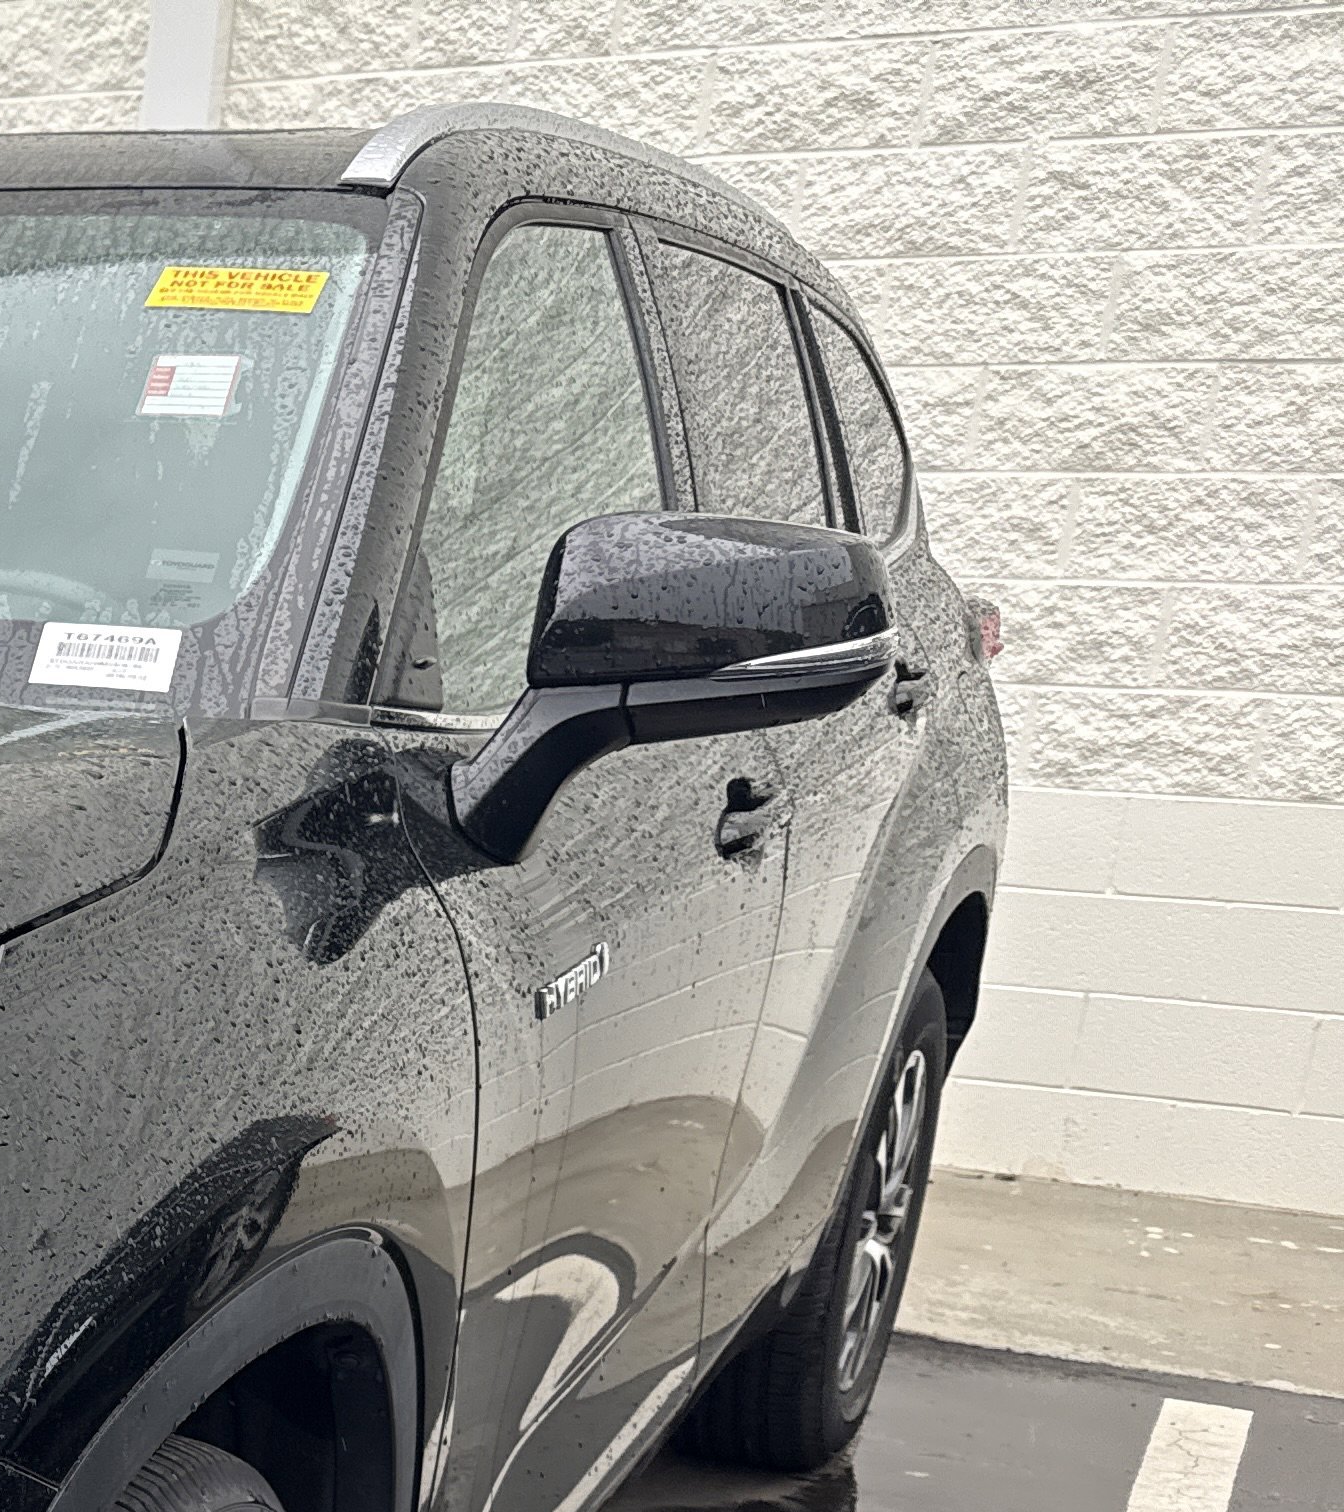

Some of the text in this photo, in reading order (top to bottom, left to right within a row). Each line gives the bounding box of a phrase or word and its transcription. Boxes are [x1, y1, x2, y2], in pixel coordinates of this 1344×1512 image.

[173, 270, 321, 283] THIS VEHICLE
[170, 280, 311, 292] NOT FOR SALE
[536, 952, 601, 1018] HYBRID
